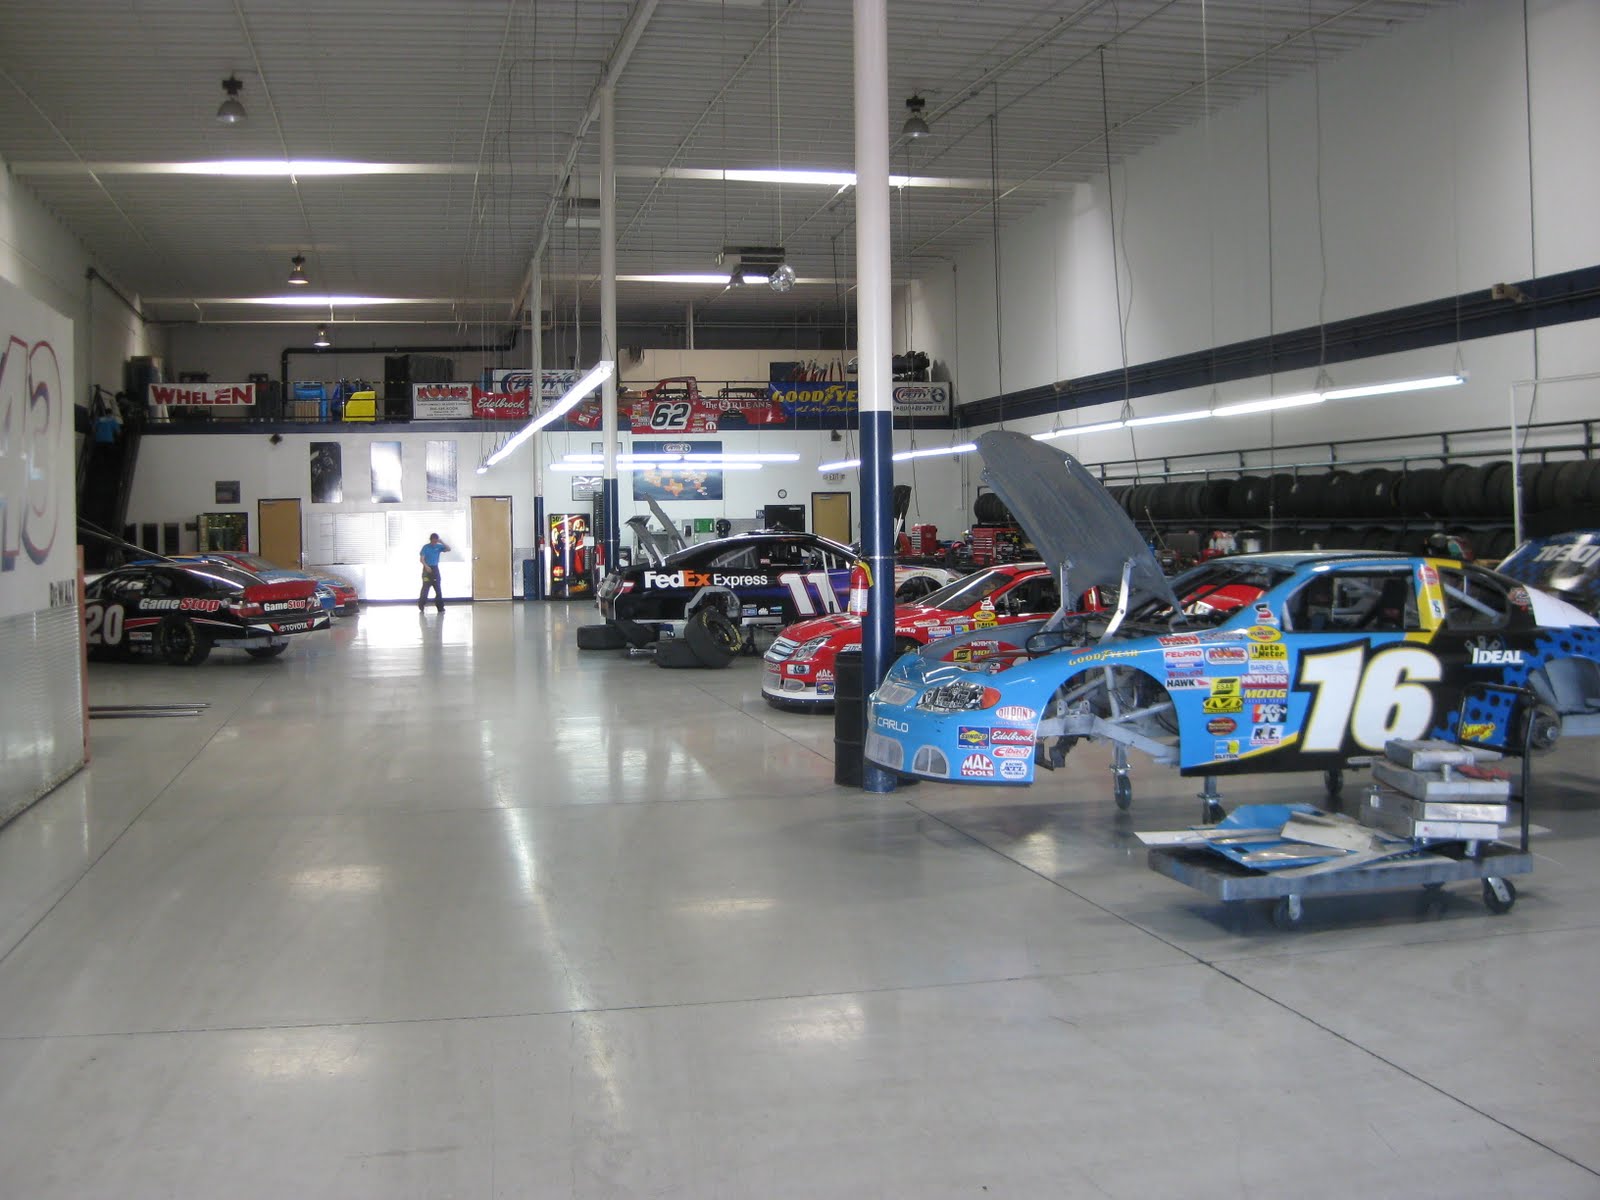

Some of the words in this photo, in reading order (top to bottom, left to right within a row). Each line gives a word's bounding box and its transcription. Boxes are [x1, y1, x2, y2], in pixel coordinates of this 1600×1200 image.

[151, 384, 253, 405] WHELEN
[772, 385, 859, 405] GOODYE
[476, 397, 526, 409] Edelbrock
[701, 401, 718, 410] The
[718, 400, 773, 411] ORLEANS
[651, 402, 692, 430] 62
[644, 570, 712, 588] FedEx
[713, 573, 768, 588] Express
[779, 572, 842, 615] 11
[139, 598, 221, 612] GameStop
[263, 599, 306, 612] GameStop
[86, 604, 124, 645] 20
[286, 622, 309, 632] TOYOTA
[1068, 650, 1139, 667] GOODYEAR
[1471, 647, 1524, 665] IDEAL
[816, 669, 834, 677] MAC
[1242, 674, 1288, 684] MOTHERS
[1166, 679, 1196, 688] HAWK
[1244, 688, 1288, 699] MOOG
[1300, 645, 1443, 752] 16
[877, 716, 909, 733] CARLO
[959, 732, 988, 740] SUNOCO
[991, 730, 1033, 742] Edelbrock
[993, 746, 1030, 757] Eibach
[962, 755, 994, 770] MAC
